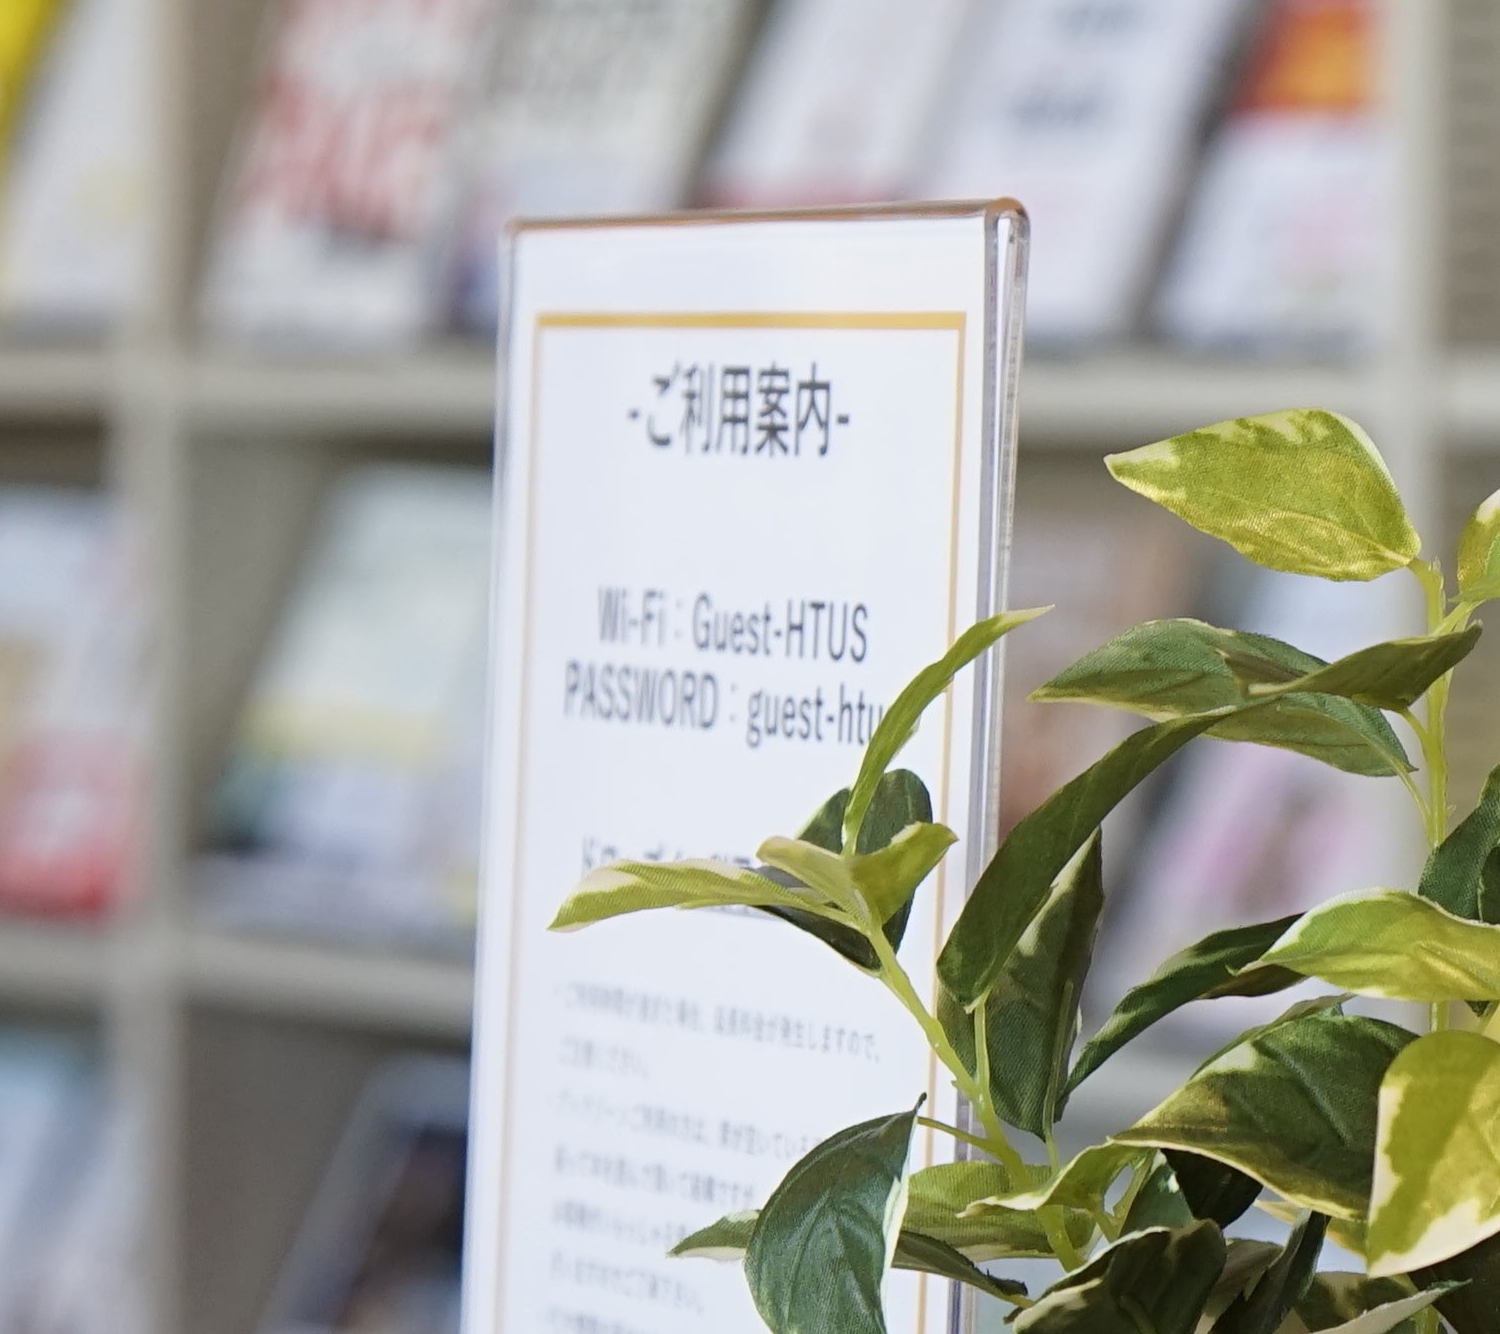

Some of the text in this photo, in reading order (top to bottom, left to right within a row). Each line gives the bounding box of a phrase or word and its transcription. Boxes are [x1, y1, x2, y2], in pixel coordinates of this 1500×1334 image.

[693, 592, 868, 663] Guest-HTUS
[563, 659, 719, 729] PASSWORD
[746, 681, 884, 748] guest-htu
